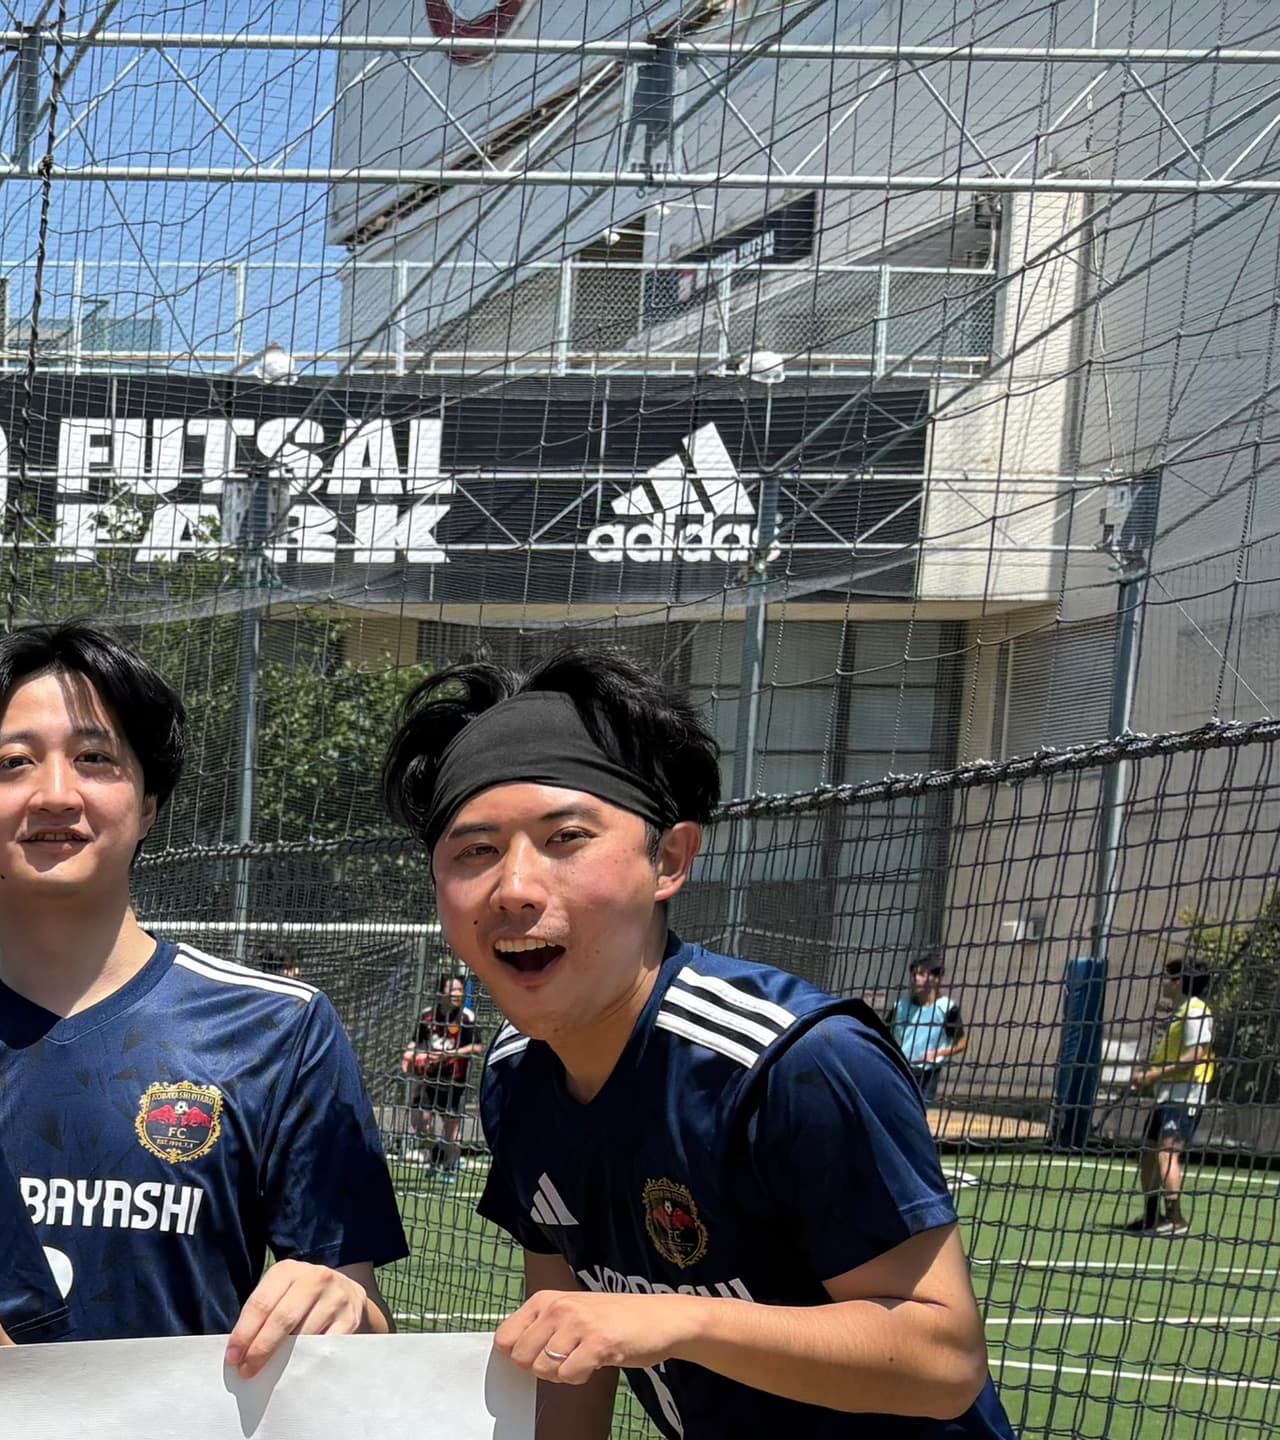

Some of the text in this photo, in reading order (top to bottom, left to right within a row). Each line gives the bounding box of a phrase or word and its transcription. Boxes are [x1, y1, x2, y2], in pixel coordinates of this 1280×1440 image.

[56, 417, 457, 496] FUTSAL
[168, 1127, 187, 1138] FC
[19, 1177, 204, 1236] BAYASHI
